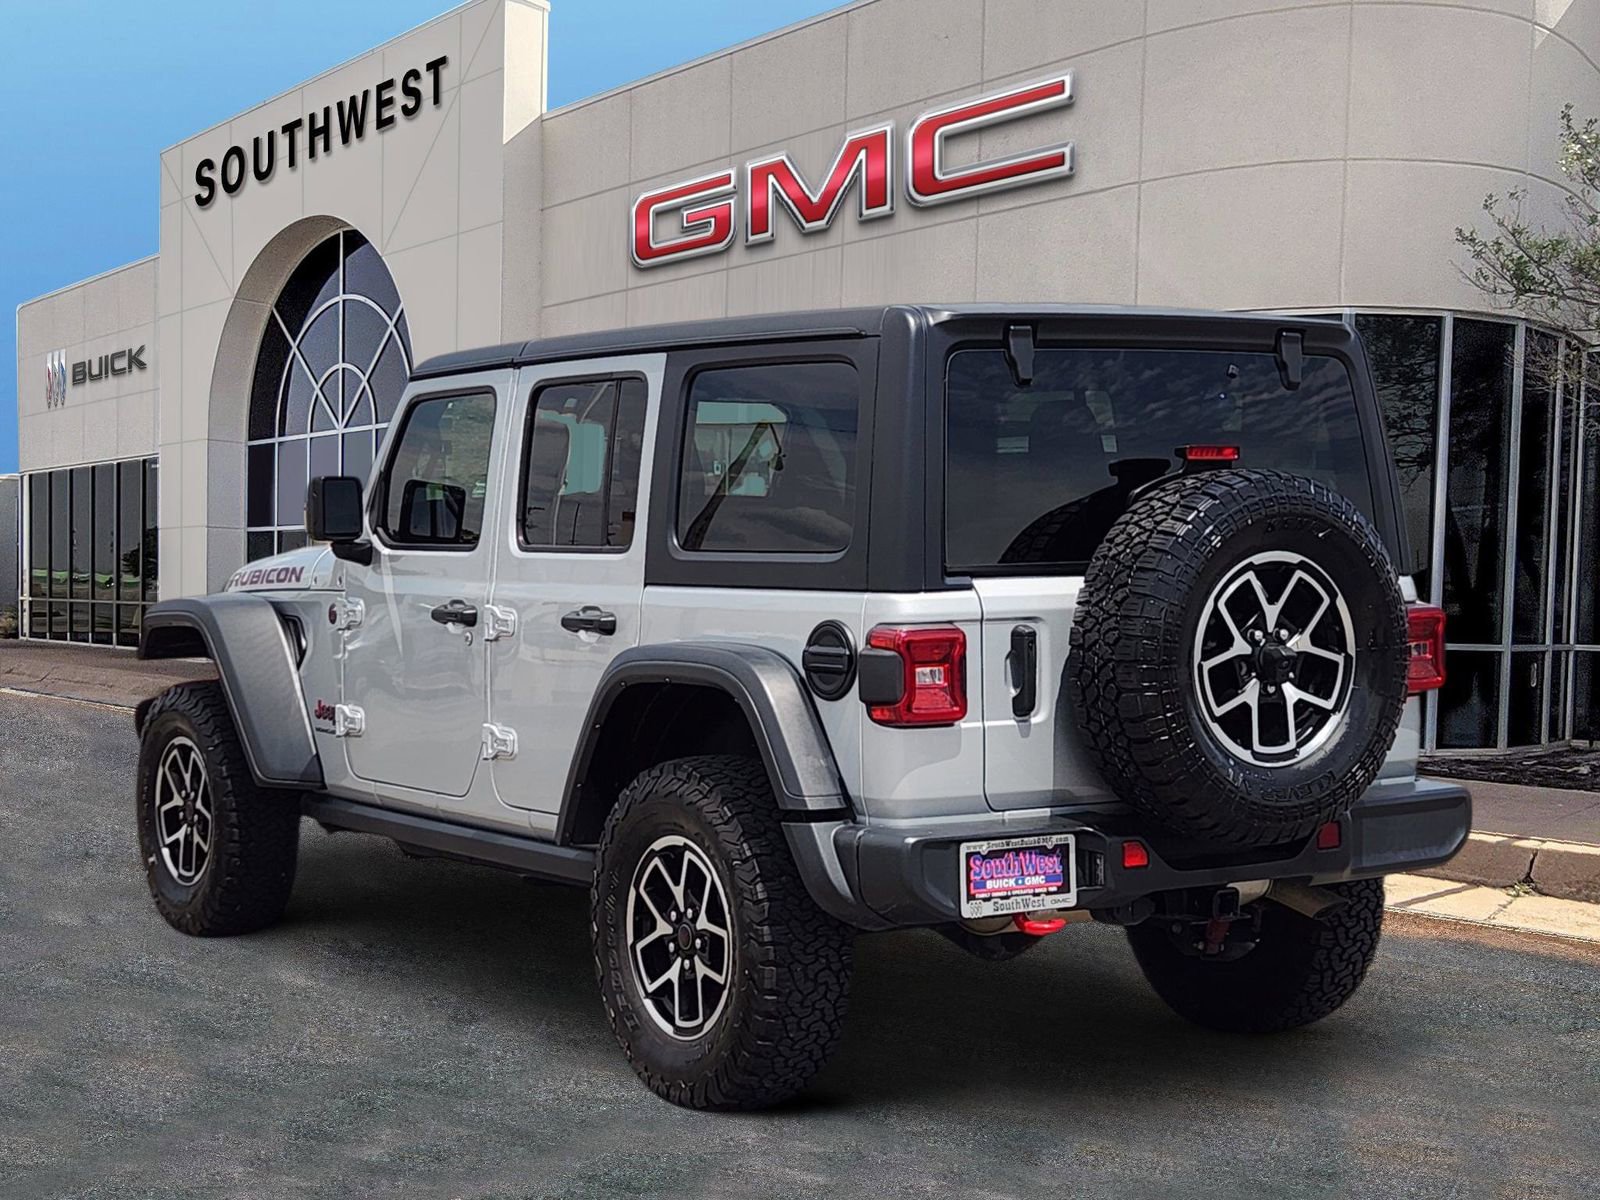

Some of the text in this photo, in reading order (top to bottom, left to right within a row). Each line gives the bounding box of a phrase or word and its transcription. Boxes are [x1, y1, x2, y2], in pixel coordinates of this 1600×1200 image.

[194, 55, 449, 207] SOUTHWEST
[630, 67, 1075, 268] GMC
[72, 344, 147, 386] BUICK
[228, 566, 305, 588] RUBICON
[970, 850, 1063, 879] SouthWest
[986, 875, 1046, 889] BUICK GMC
[993, 897, 1072, 911] SouthWest GMC
